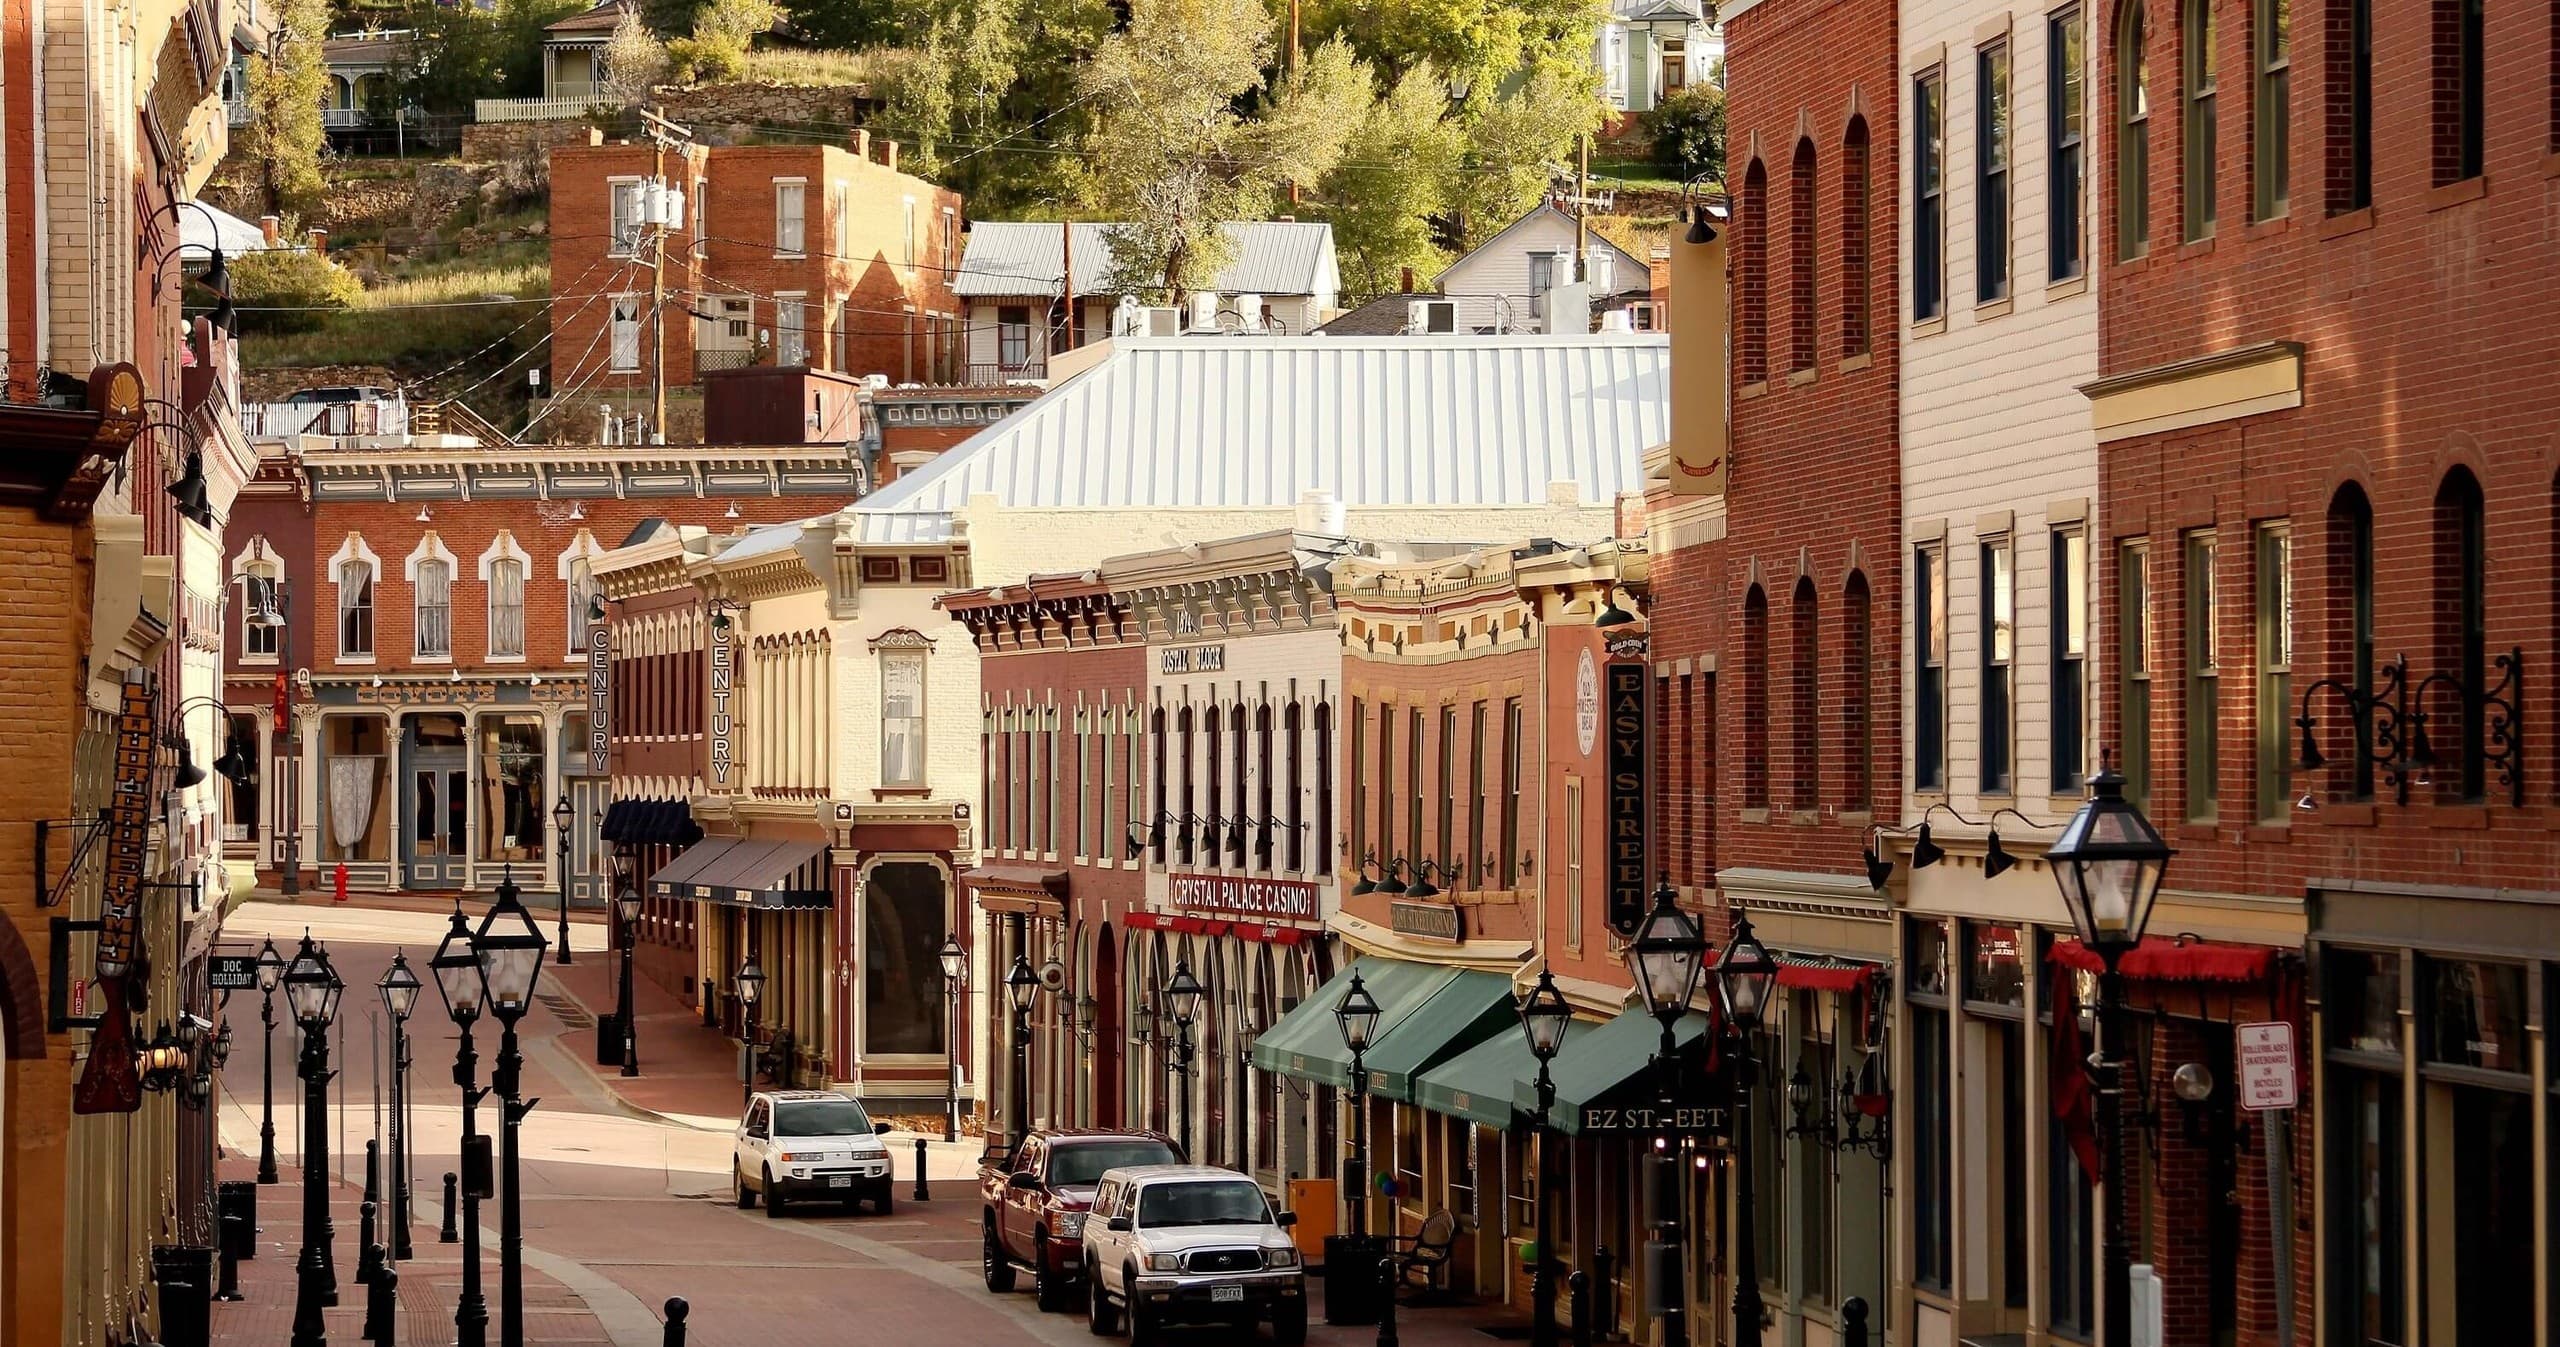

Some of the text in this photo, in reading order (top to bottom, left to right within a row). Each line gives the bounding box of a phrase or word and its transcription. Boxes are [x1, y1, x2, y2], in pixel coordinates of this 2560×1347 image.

[1610, 640, 1628, 652] GOLD
[1195, 646, 1222, 671] BLOCK
[357, 684, 497, 704] COYOTE
[593, 630, 608, 771] CENTURY
[712, 624, 731, 783] CENTURY
[1615, 674, 1642, 906] EASY STREET
[1174, 879, 1308, 916] CRYSTAL PALACE CASINO
[223, 960, 242, 972] DOC
[212, 973, 252, 985] HOLLIDAY
[1585, 1108, 1725, 1129] EZ STEET
